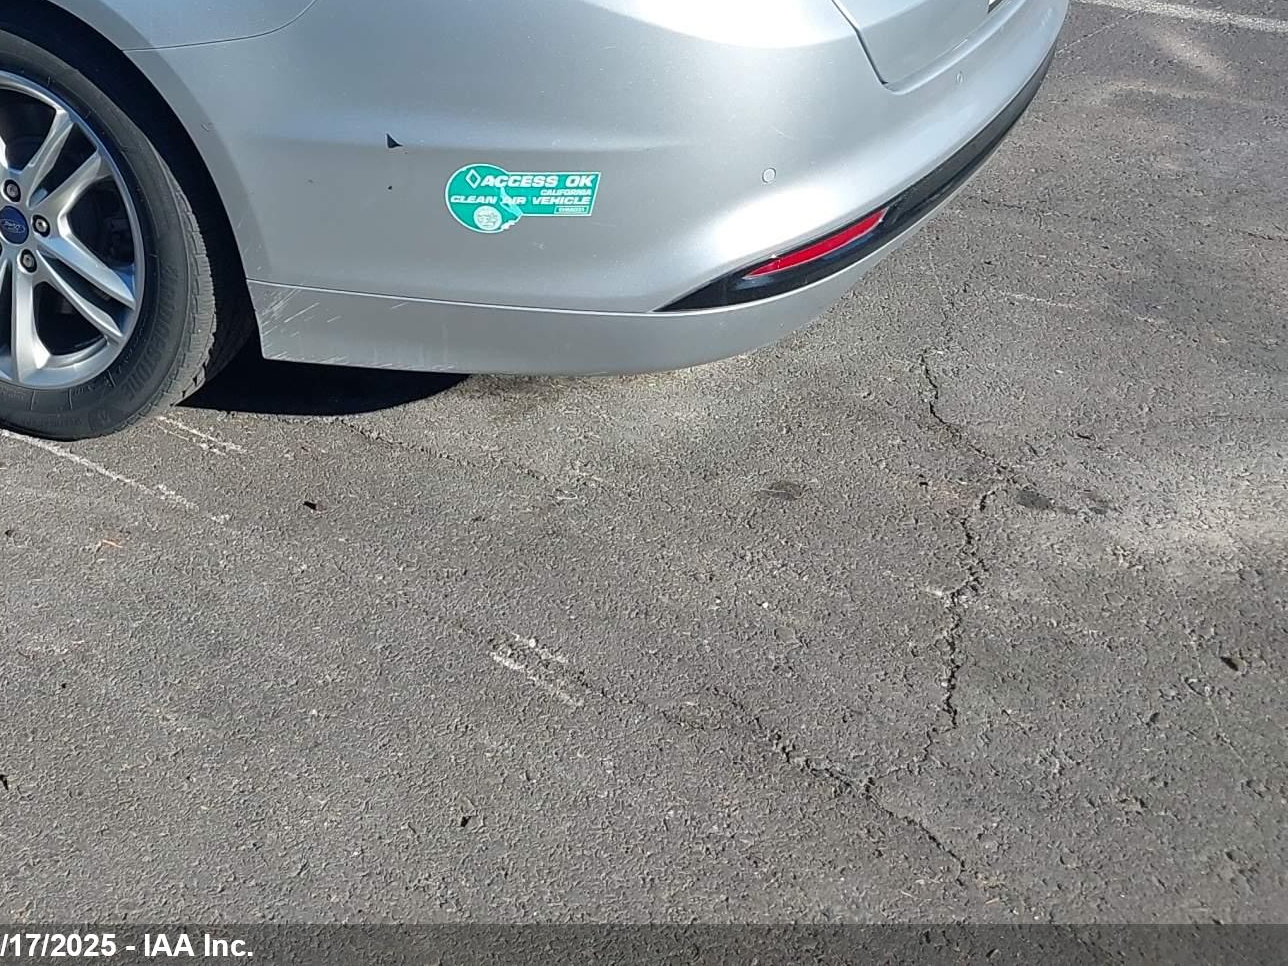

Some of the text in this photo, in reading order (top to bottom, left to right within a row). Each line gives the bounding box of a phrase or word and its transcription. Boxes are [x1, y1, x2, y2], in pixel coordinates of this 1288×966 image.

[480, 174, 596, 188] ACCESS OK
[450, 195, 592, 205] CLEAN AIR VEHICLE
